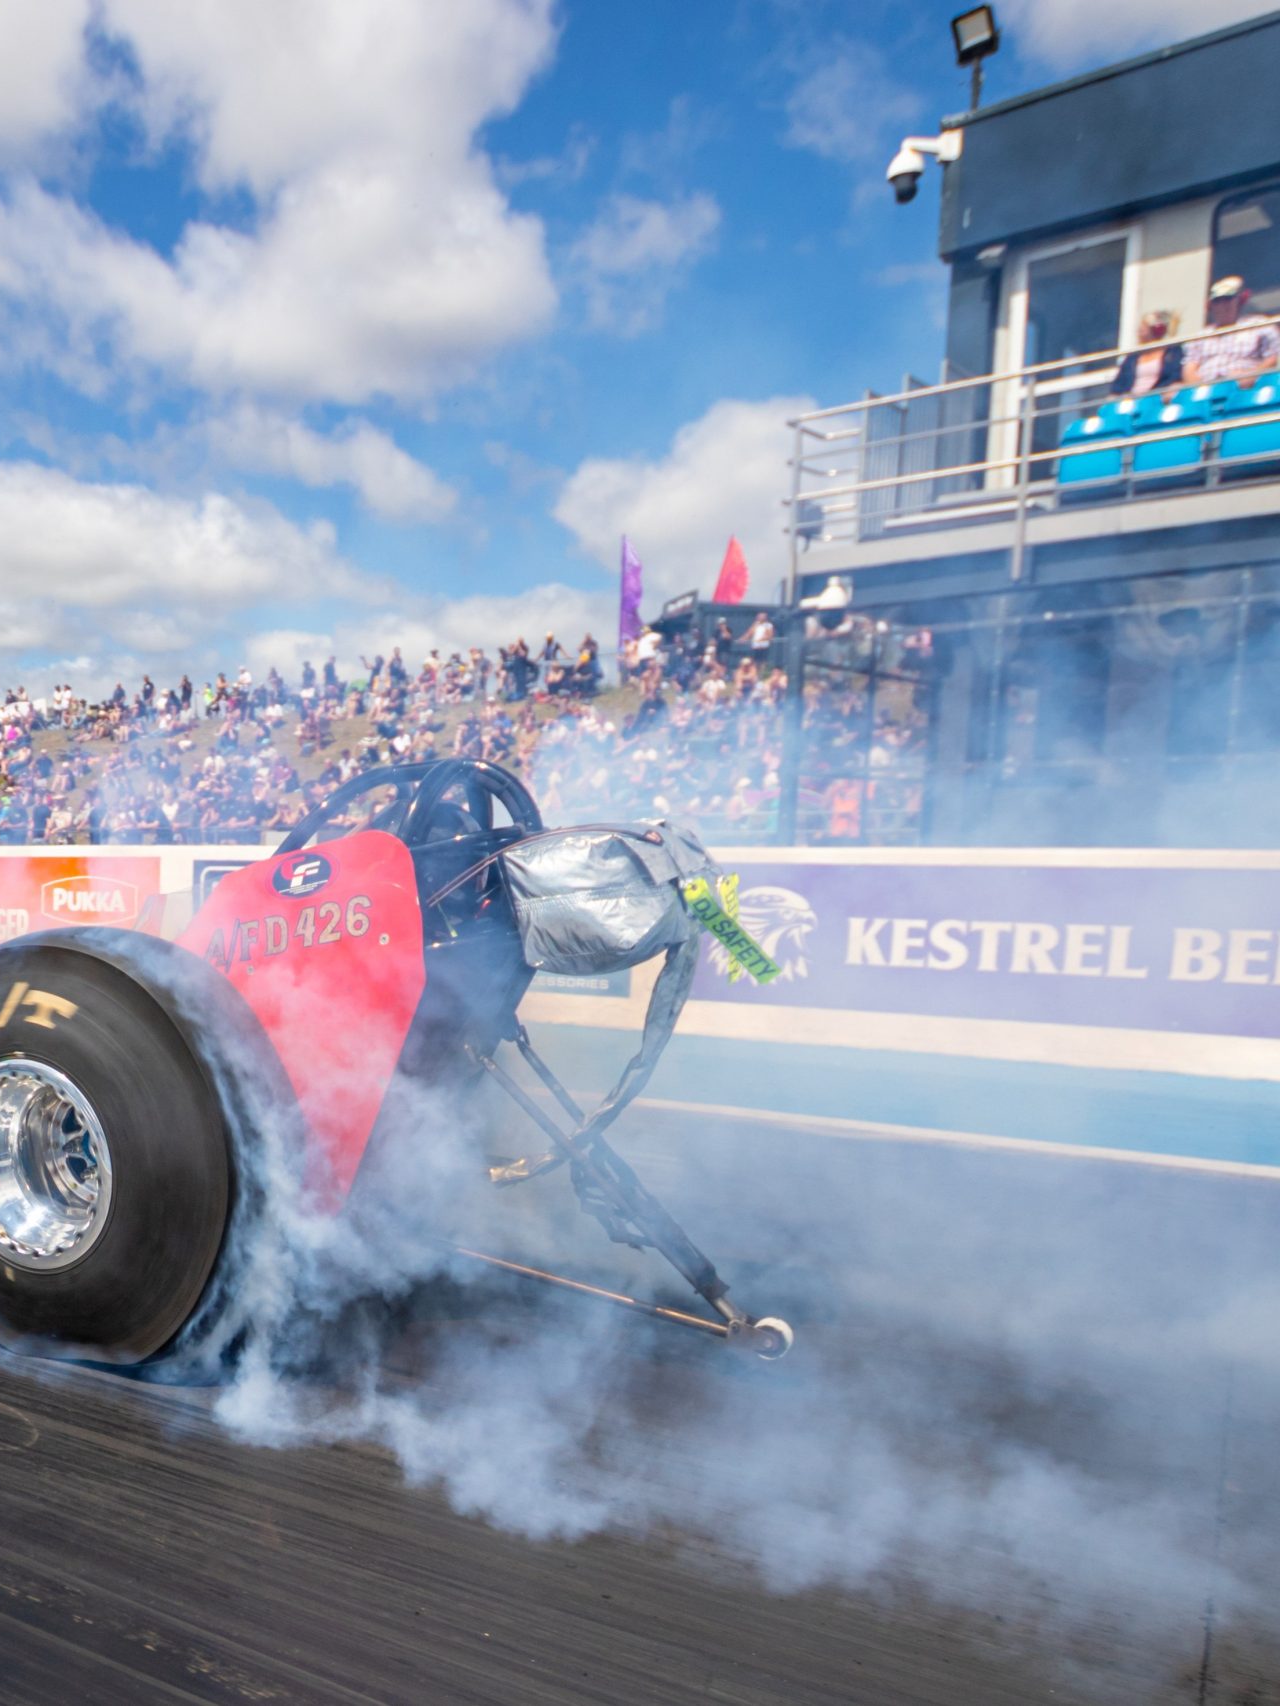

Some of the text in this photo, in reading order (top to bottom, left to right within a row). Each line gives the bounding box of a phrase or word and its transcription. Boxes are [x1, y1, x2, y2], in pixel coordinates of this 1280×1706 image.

[52, 887, 126, 912] PUKKA
[294, 895, 372, 947] 426
[693, 898, 776, 976] DJ SAFETY
[843, 917, 1280, 986] KESTREL BE
